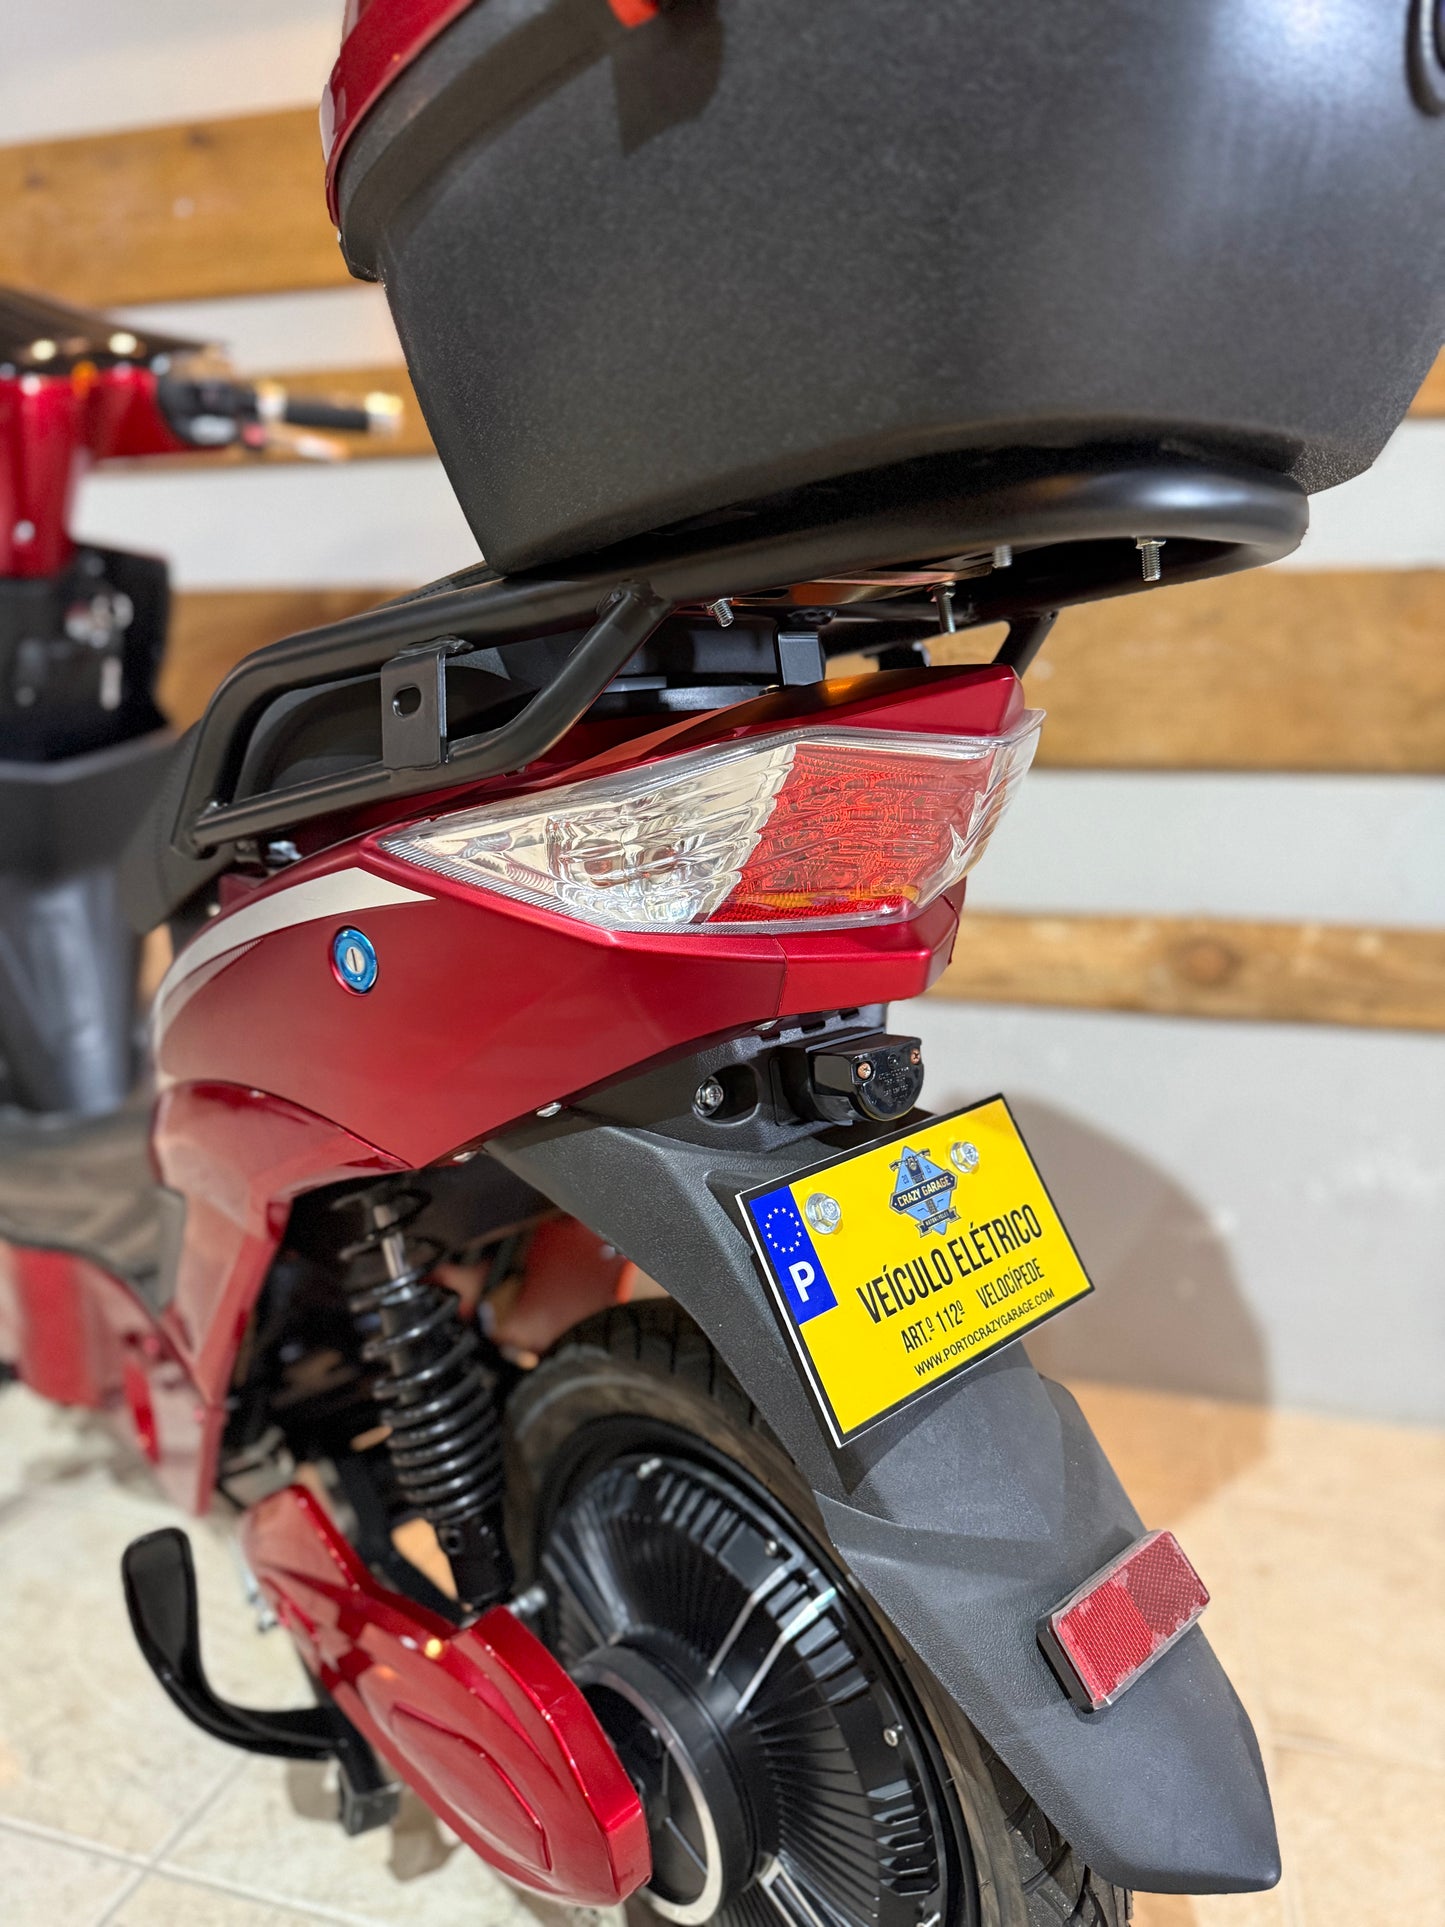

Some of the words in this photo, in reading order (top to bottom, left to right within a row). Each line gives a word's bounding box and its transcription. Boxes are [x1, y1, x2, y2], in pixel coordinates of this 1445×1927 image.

[896, 1188, 922, 1207] CRAZY
[921, 1175, 952, 1197] GARAGE
[789, 1260, 816, 1303] P
[856, 1248, 954, 1324] VEÍCULO
[947, 1204, 1043, 1278] ELÉTRICO
[935, 1300, 966, 1333] 112º
[975, 1257, 1045, 1310] VELOCÍPEDE
[914, 1287, 1056, 1377] WWW.PORTOCRAZYGARAGE.COM
